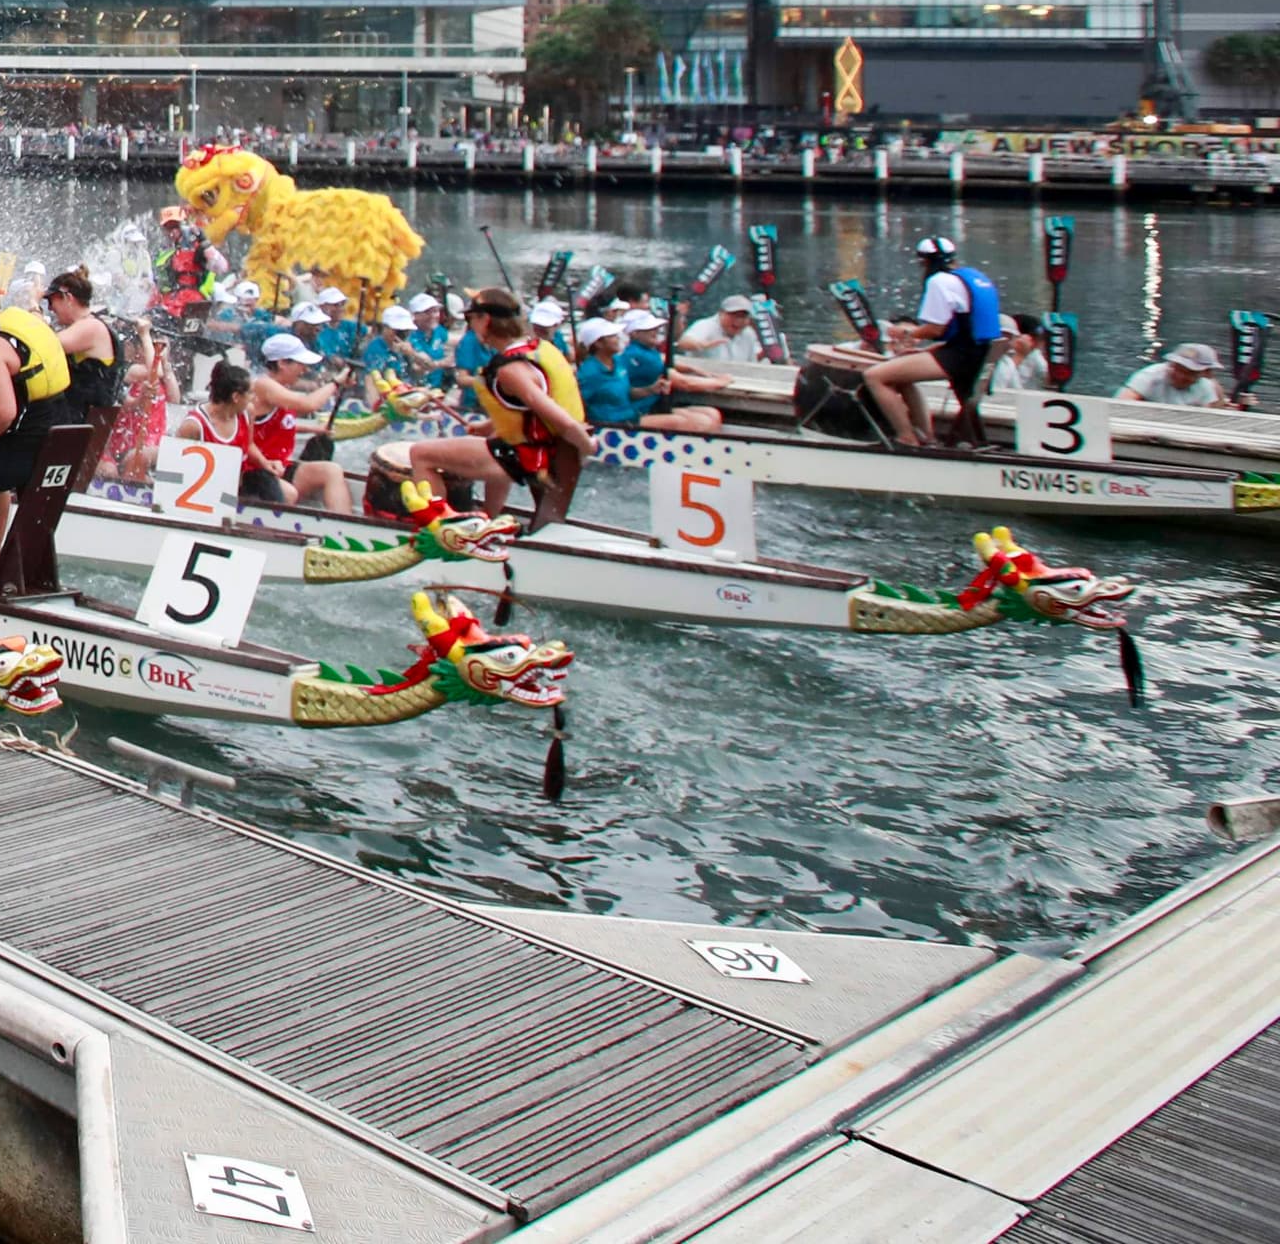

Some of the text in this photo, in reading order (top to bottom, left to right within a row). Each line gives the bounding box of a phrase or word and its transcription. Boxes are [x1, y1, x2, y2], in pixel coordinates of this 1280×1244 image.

[1040, 399, 1085, 454] 3
[44, 467, 67, 485] 46
[175, 445, 216, 514] 2
[1001, 468, 1079, 494] NSW45
[677, 472, 726, 547] 5
[165, 541, 233, 625] 5
[148, 662, 196, 693] BuK
[707, 946, 779, 973] 46
[208, 1165, 291, 1217] 47
